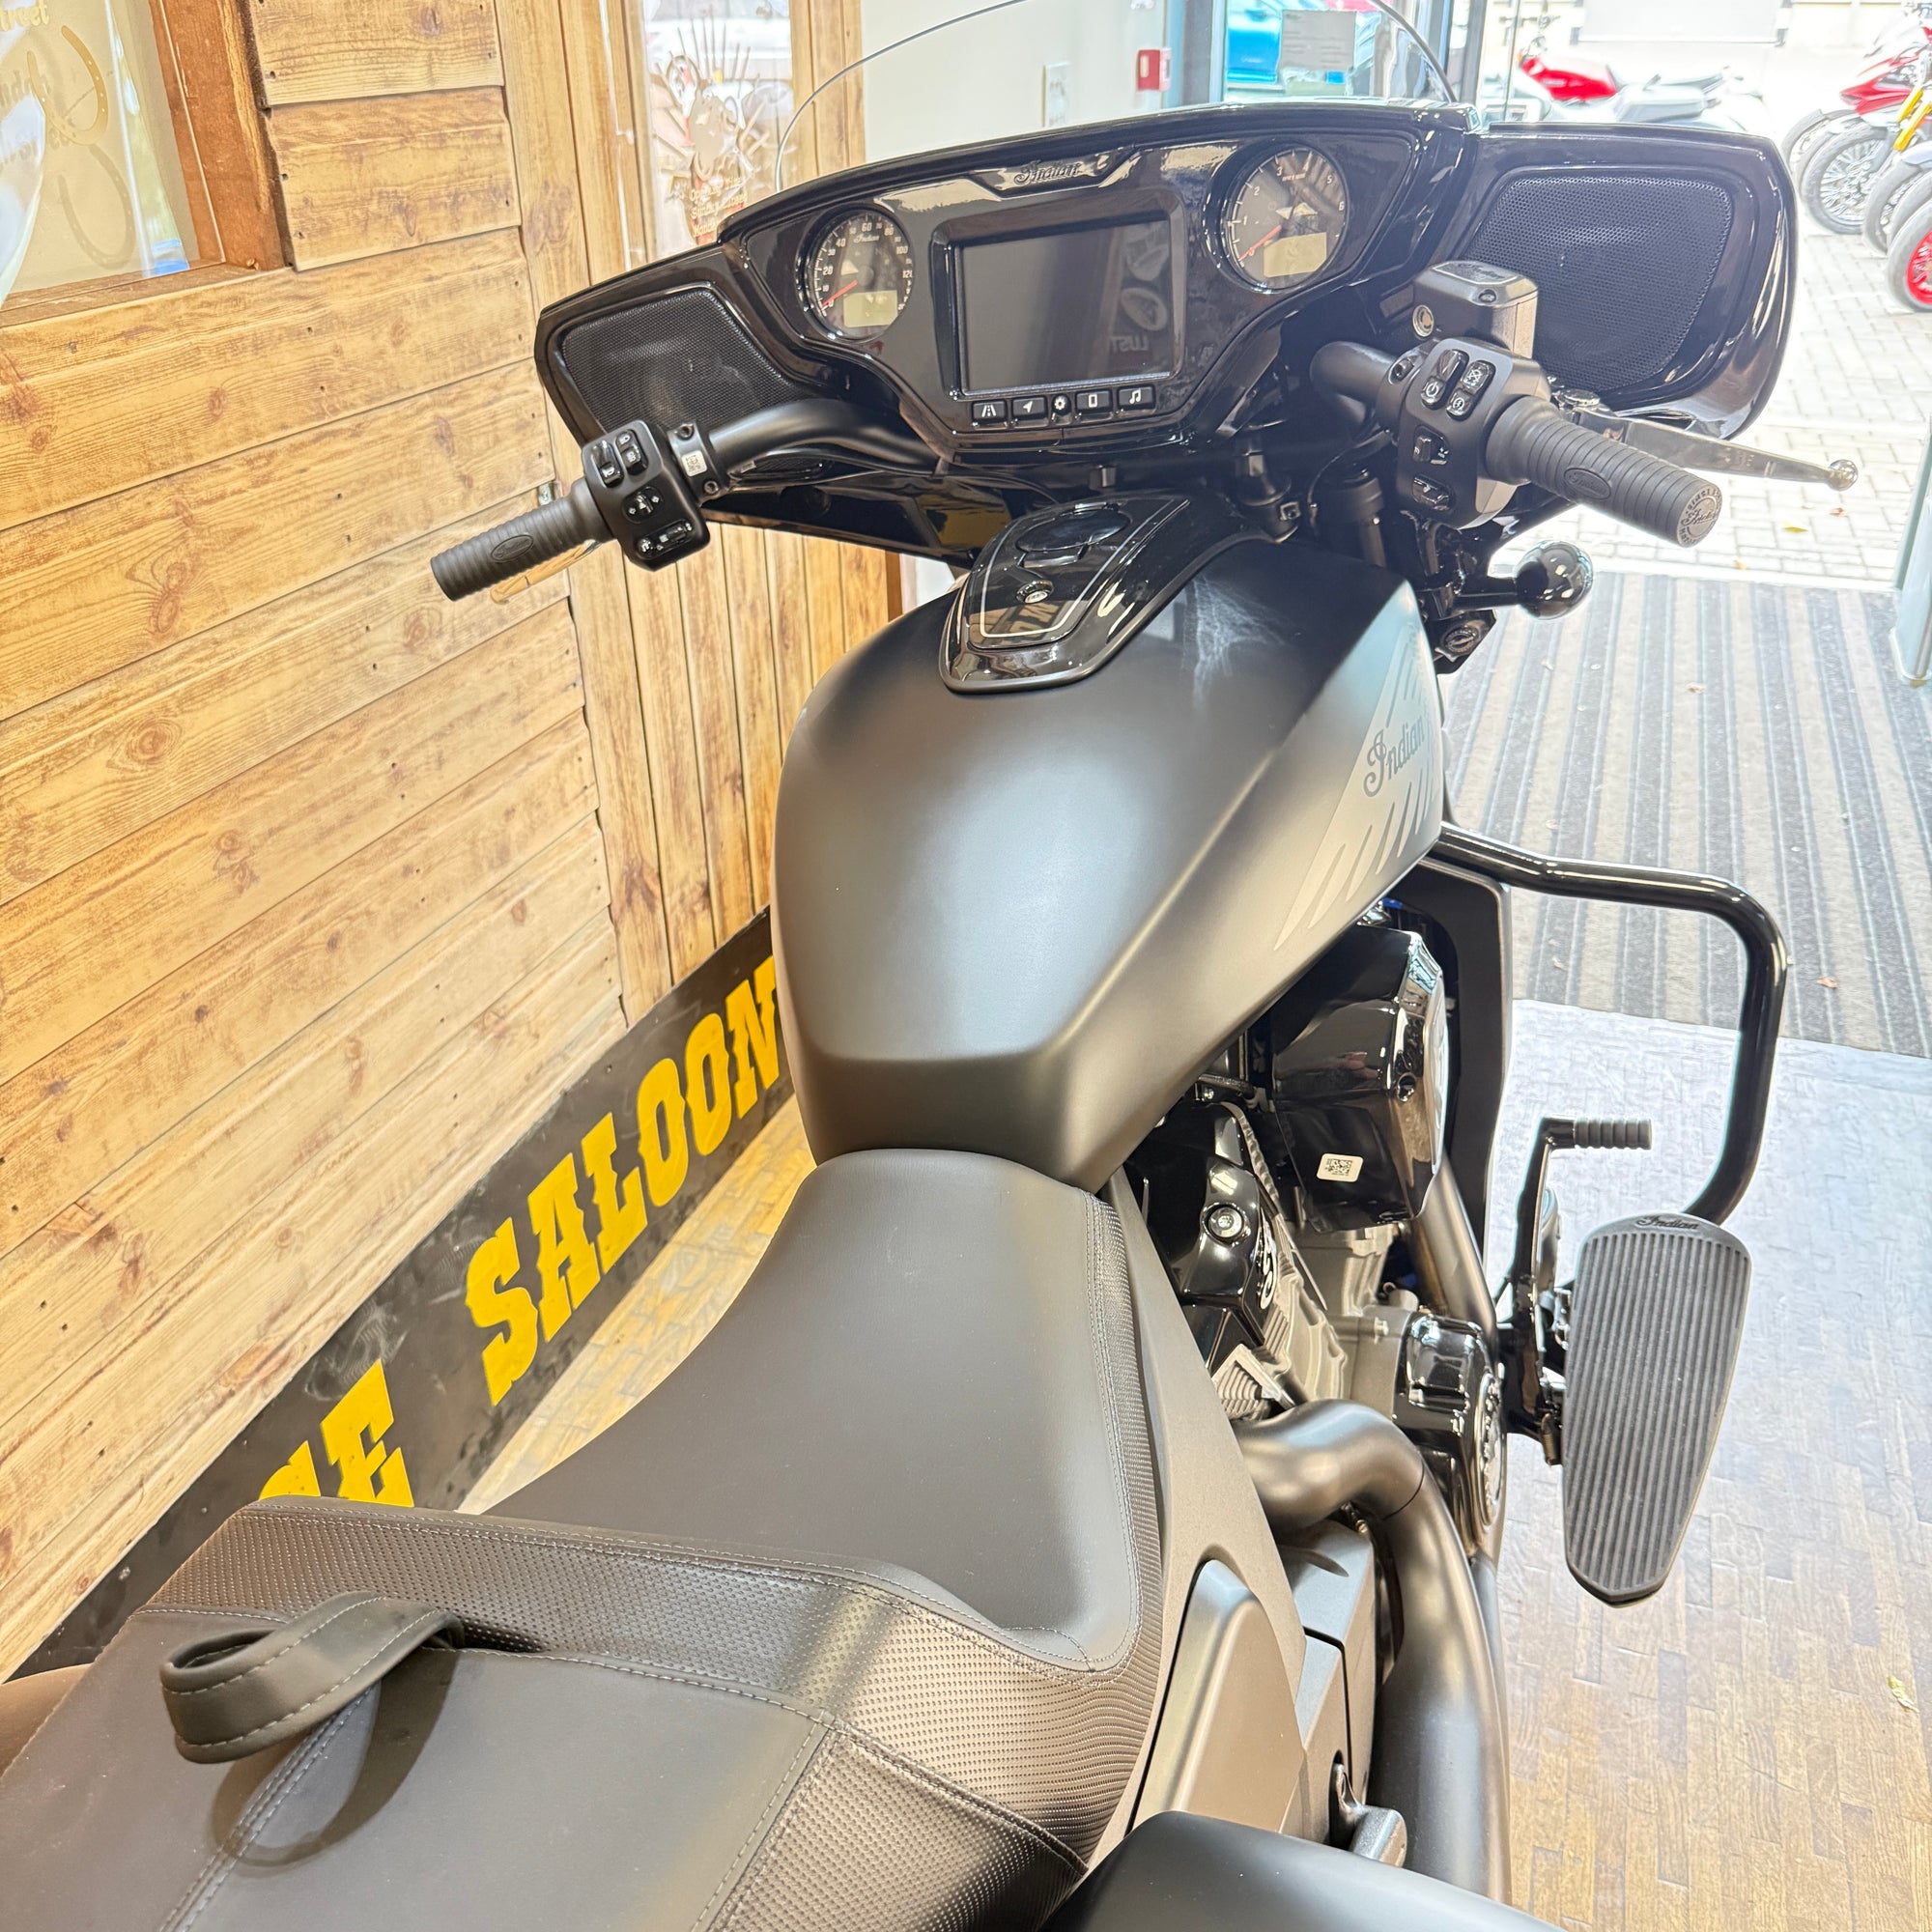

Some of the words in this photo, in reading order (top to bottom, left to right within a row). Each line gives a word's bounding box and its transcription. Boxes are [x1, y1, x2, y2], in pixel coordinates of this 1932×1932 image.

[1276, 166, 1283, 176] 3
[1326, 175, 1333, 184] 5
[1254, 185, 1260, 195] 2
[1338, 201, 1345, 211] 6
[1243, 215, 1248, 225] 1
[862, 222, 872, 232] 60
[884, 227, 895, 236] 80
[836, 238, 846, 247] 40
[895, 245, 908, 255] 100
[823, 266, 834, 275] 20
[1363, 716, 1425, 798] Indian
[465, 955, 778, 1407] SALOON
[1635, 1215, 1700, 1230] Indian
[259, 1358, 414, 1507] E
